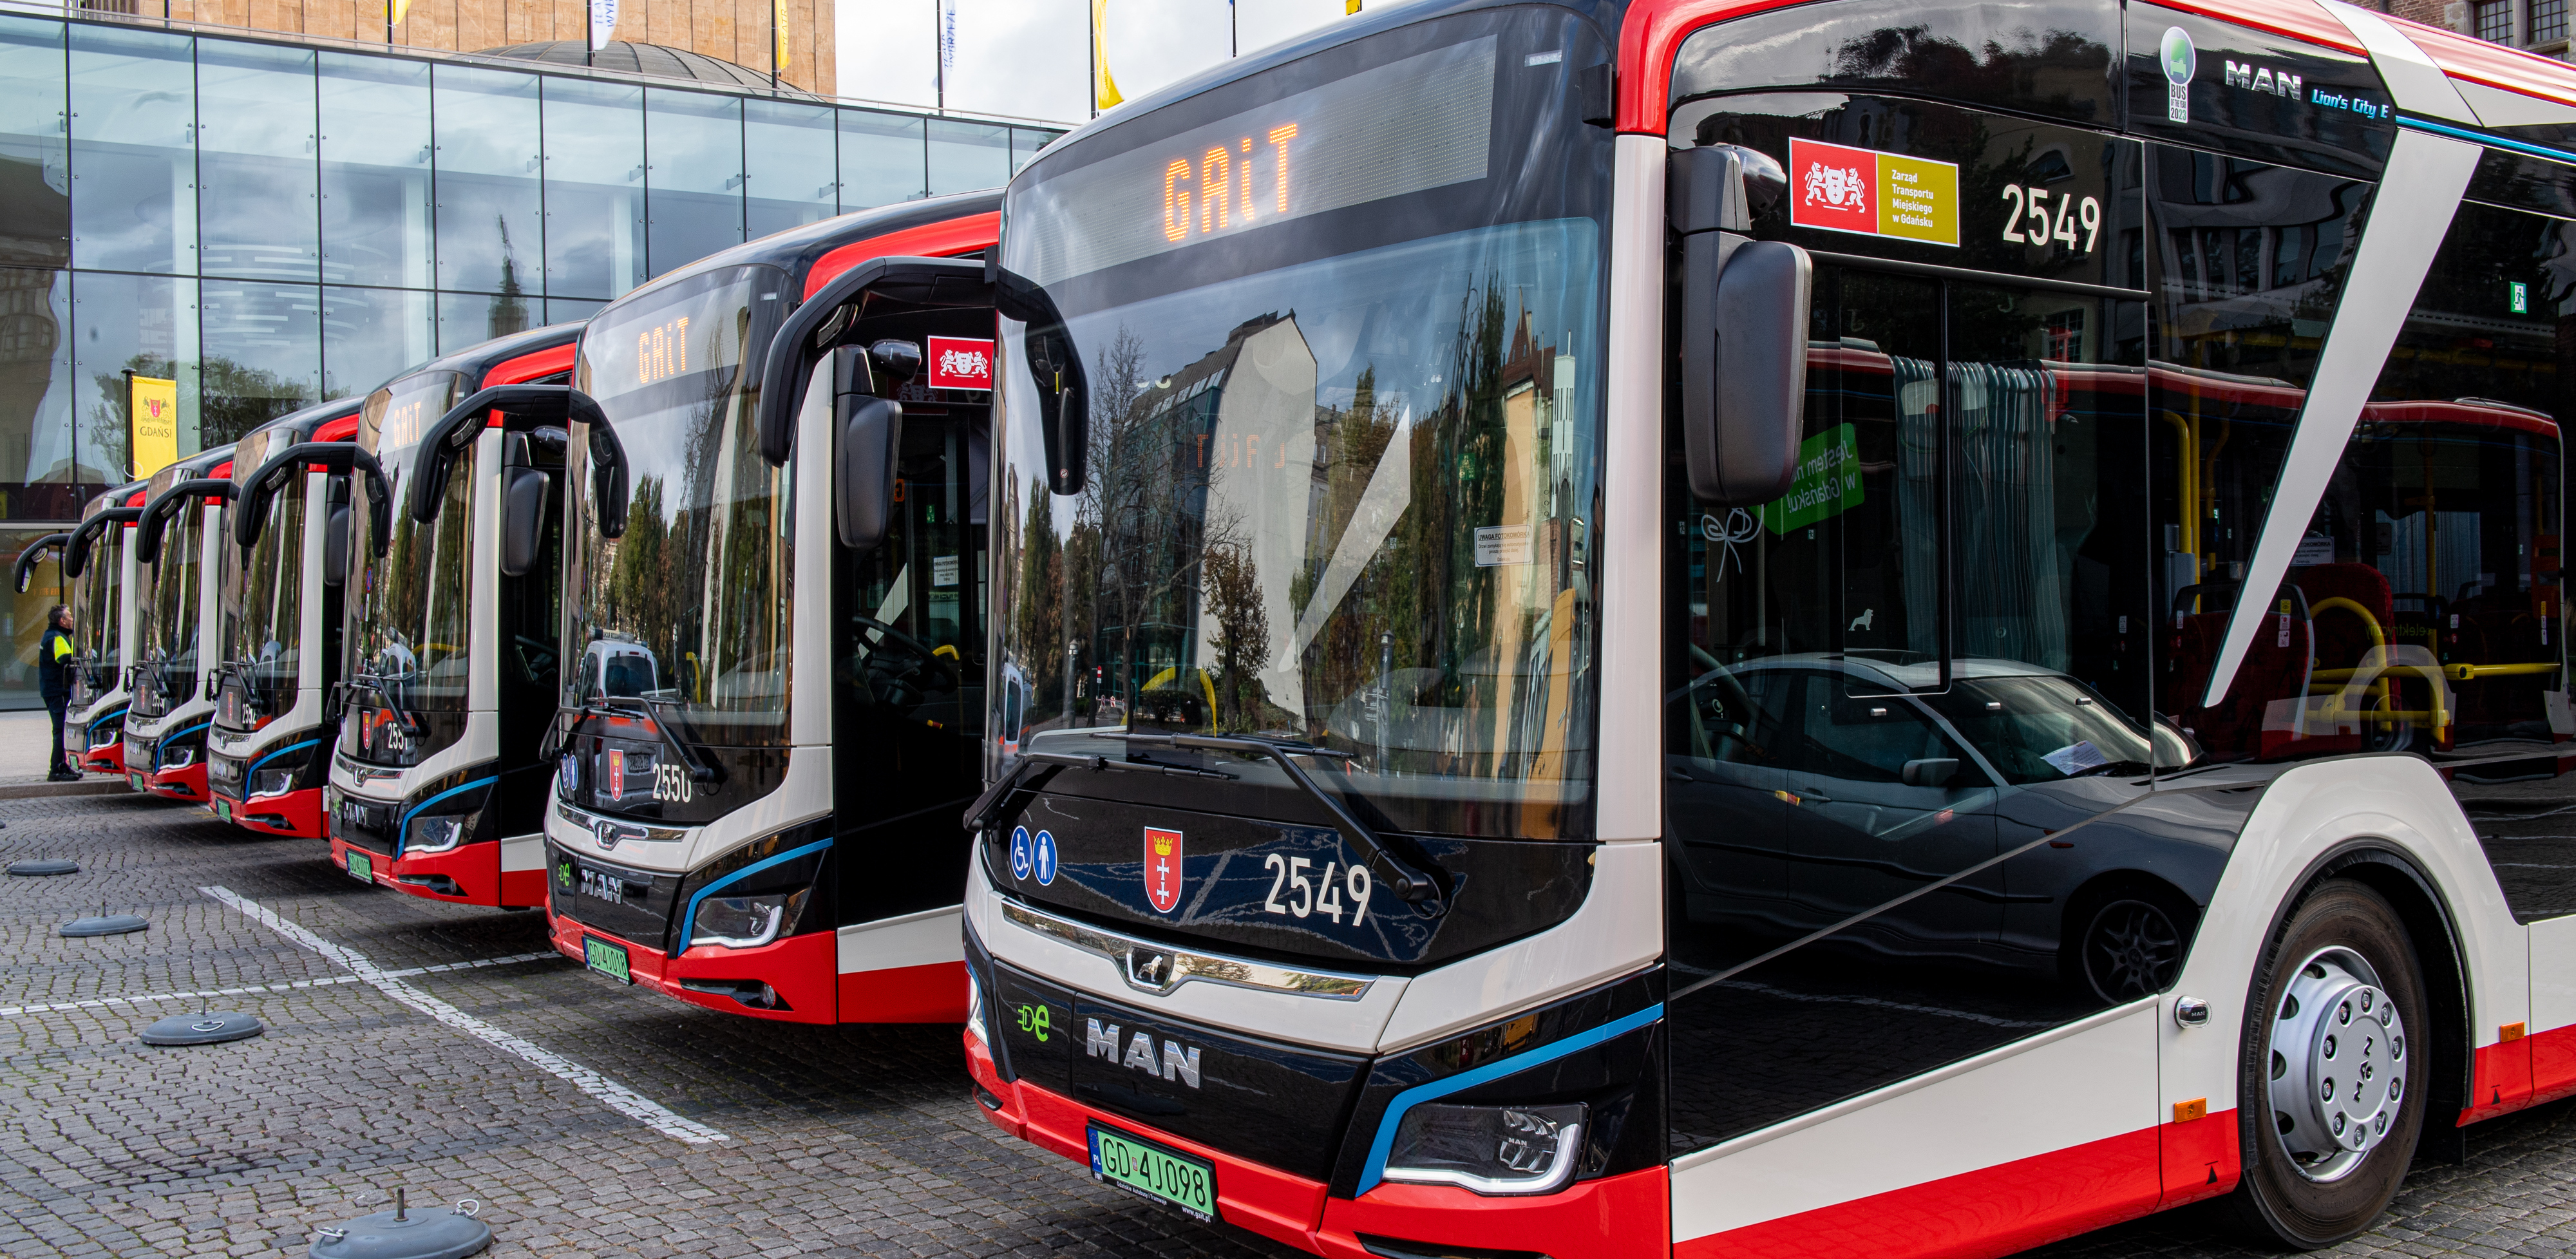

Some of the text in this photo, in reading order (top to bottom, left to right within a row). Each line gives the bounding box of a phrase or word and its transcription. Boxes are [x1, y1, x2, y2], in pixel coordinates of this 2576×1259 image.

[2171, 84, 2186, 100] BUS
[2226, 60, 2302, 100] MAN
[2171, 108, 2186, 120] 2023
[2311, 89, 2389, 119] Lion's City E
[1891, 169, 1918, 185] Zarząd
[1891, 184, 1934, 200] Transportu
[1892, 198, 1933, 214] Miejskiego
[1892, 214, 1933, 227] w Gdańsku
[2002, 184, 2100, 252] 2549
[653, 763, 692, 803] 2550
[581, 869, 623, 905] MAN
[1265, 853, 1371, 927] 2549
[589, 942, 601, 966] GD
[603, 947, 627, 976] 4J018
[1087, 1018, 1203, 1089] MAN
[2353, 1034, 2374, 1104] MAN
[1508, 1137, 1527, 1146] MAN
[1093, 1137, 1206, 1207] PL GD 4J098
[1117, 1181, 1132, 1192] Gdańskie
[1132, 1187, 1148, 1199] Autobusy
[1150, 1193, 1167, 1206] Tramwaje
[1182, 1206, 1211, 1223] www.gait.pl
